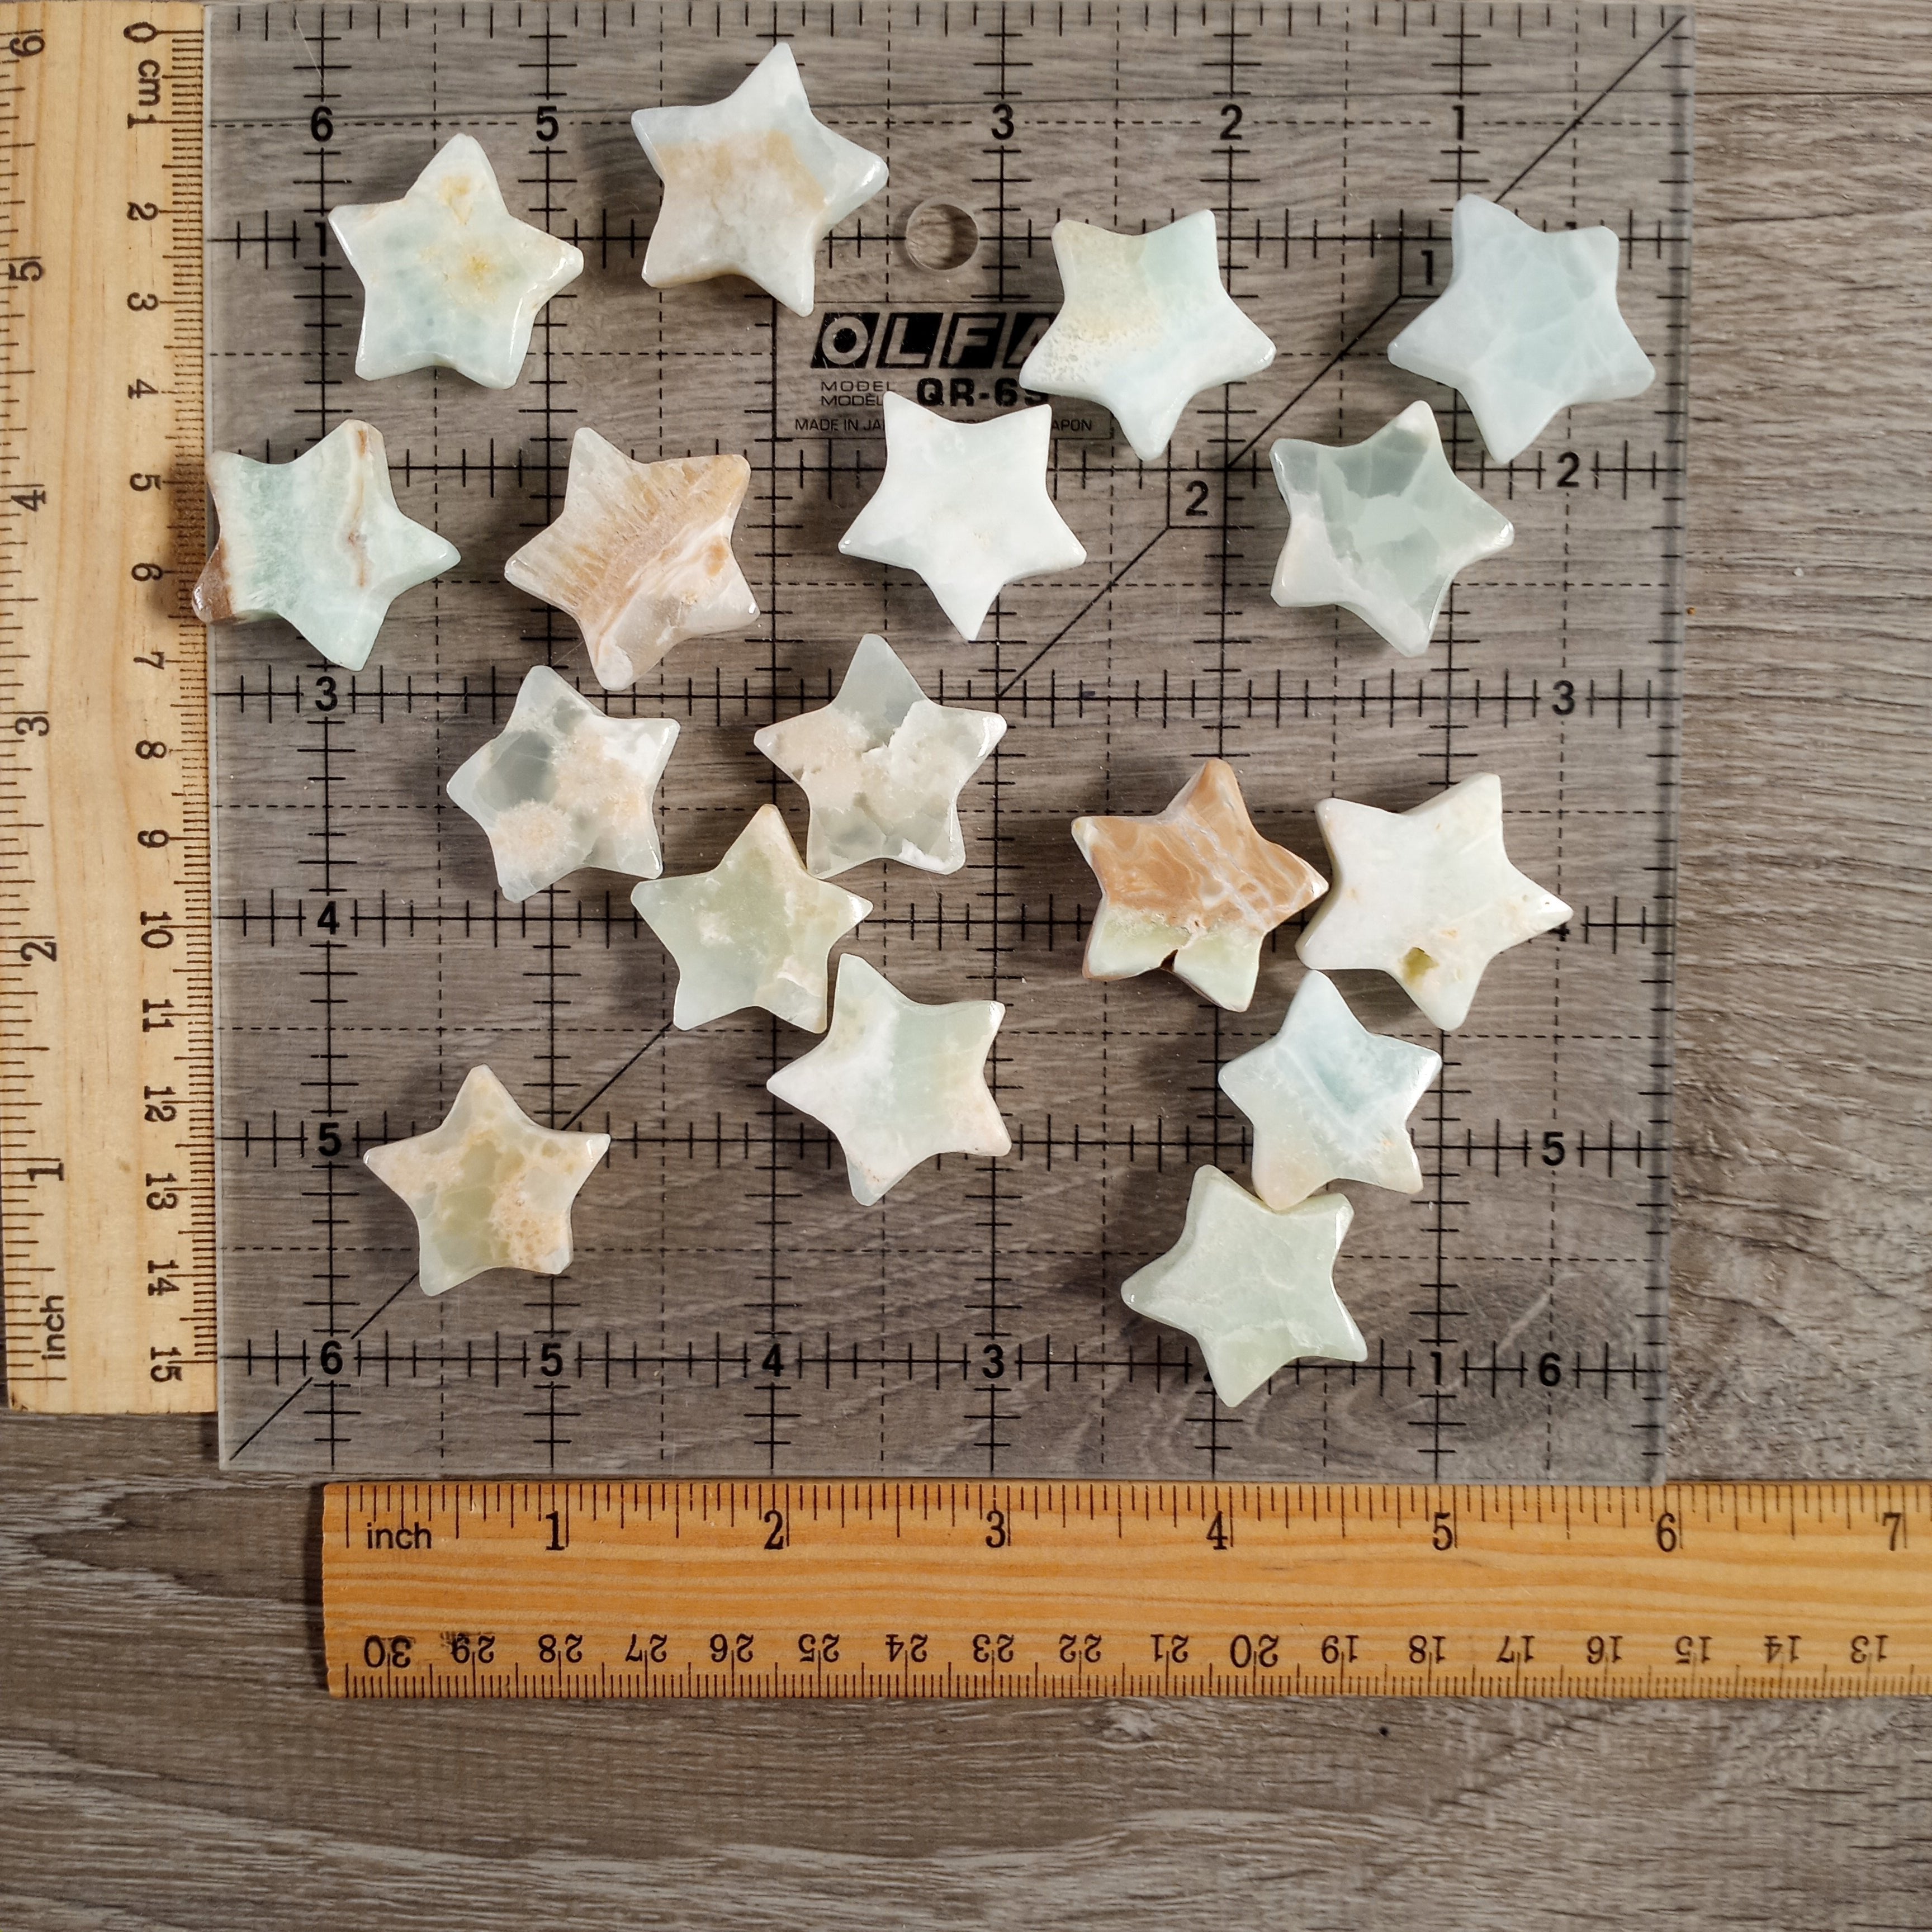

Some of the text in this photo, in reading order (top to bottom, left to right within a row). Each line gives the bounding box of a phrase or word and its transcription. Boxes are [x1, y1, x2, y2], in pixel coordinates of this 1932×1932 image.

[311, 104, 1465, 142] 6 5 3 2 1
[315, 222, 326, 257] 1
[1421, 250, 1433, 285] 1
[821, 381, 895, 392] MODEL
[821, 392, 883, 406] MODÈL
[795, 419, 838, 430] MADE
[844, 419, 858, 430] IN
[1557, 452, 1580, 487] 2
[1185, 481, 1209, 515] 2
[8, 35, 65, 1360] inch 1 2 3 4 5 6
[124, 21, 183, 1382] 0 cm 1 2 3 4 5 6 7 8 9 10 11 12 13 14 15
[315, 676, 338, 711] 3
[1552, 680, 1575, 716] 3
[317, 901, 340, 935] 4
[319, 1123, 342, 1156] 5
[1541, 1131, 1565, 1166] 5
[320, 1341, 1561, 1386] 6 5 4 3 1 6
[367, 1510, 1902, 1552] inch 1 2 3 4 5 6 7
[364, 1632, 1888, 1668] 13 14 15 16 17 18 19 20 21 22 23 24 25 26 27 28 29 30
